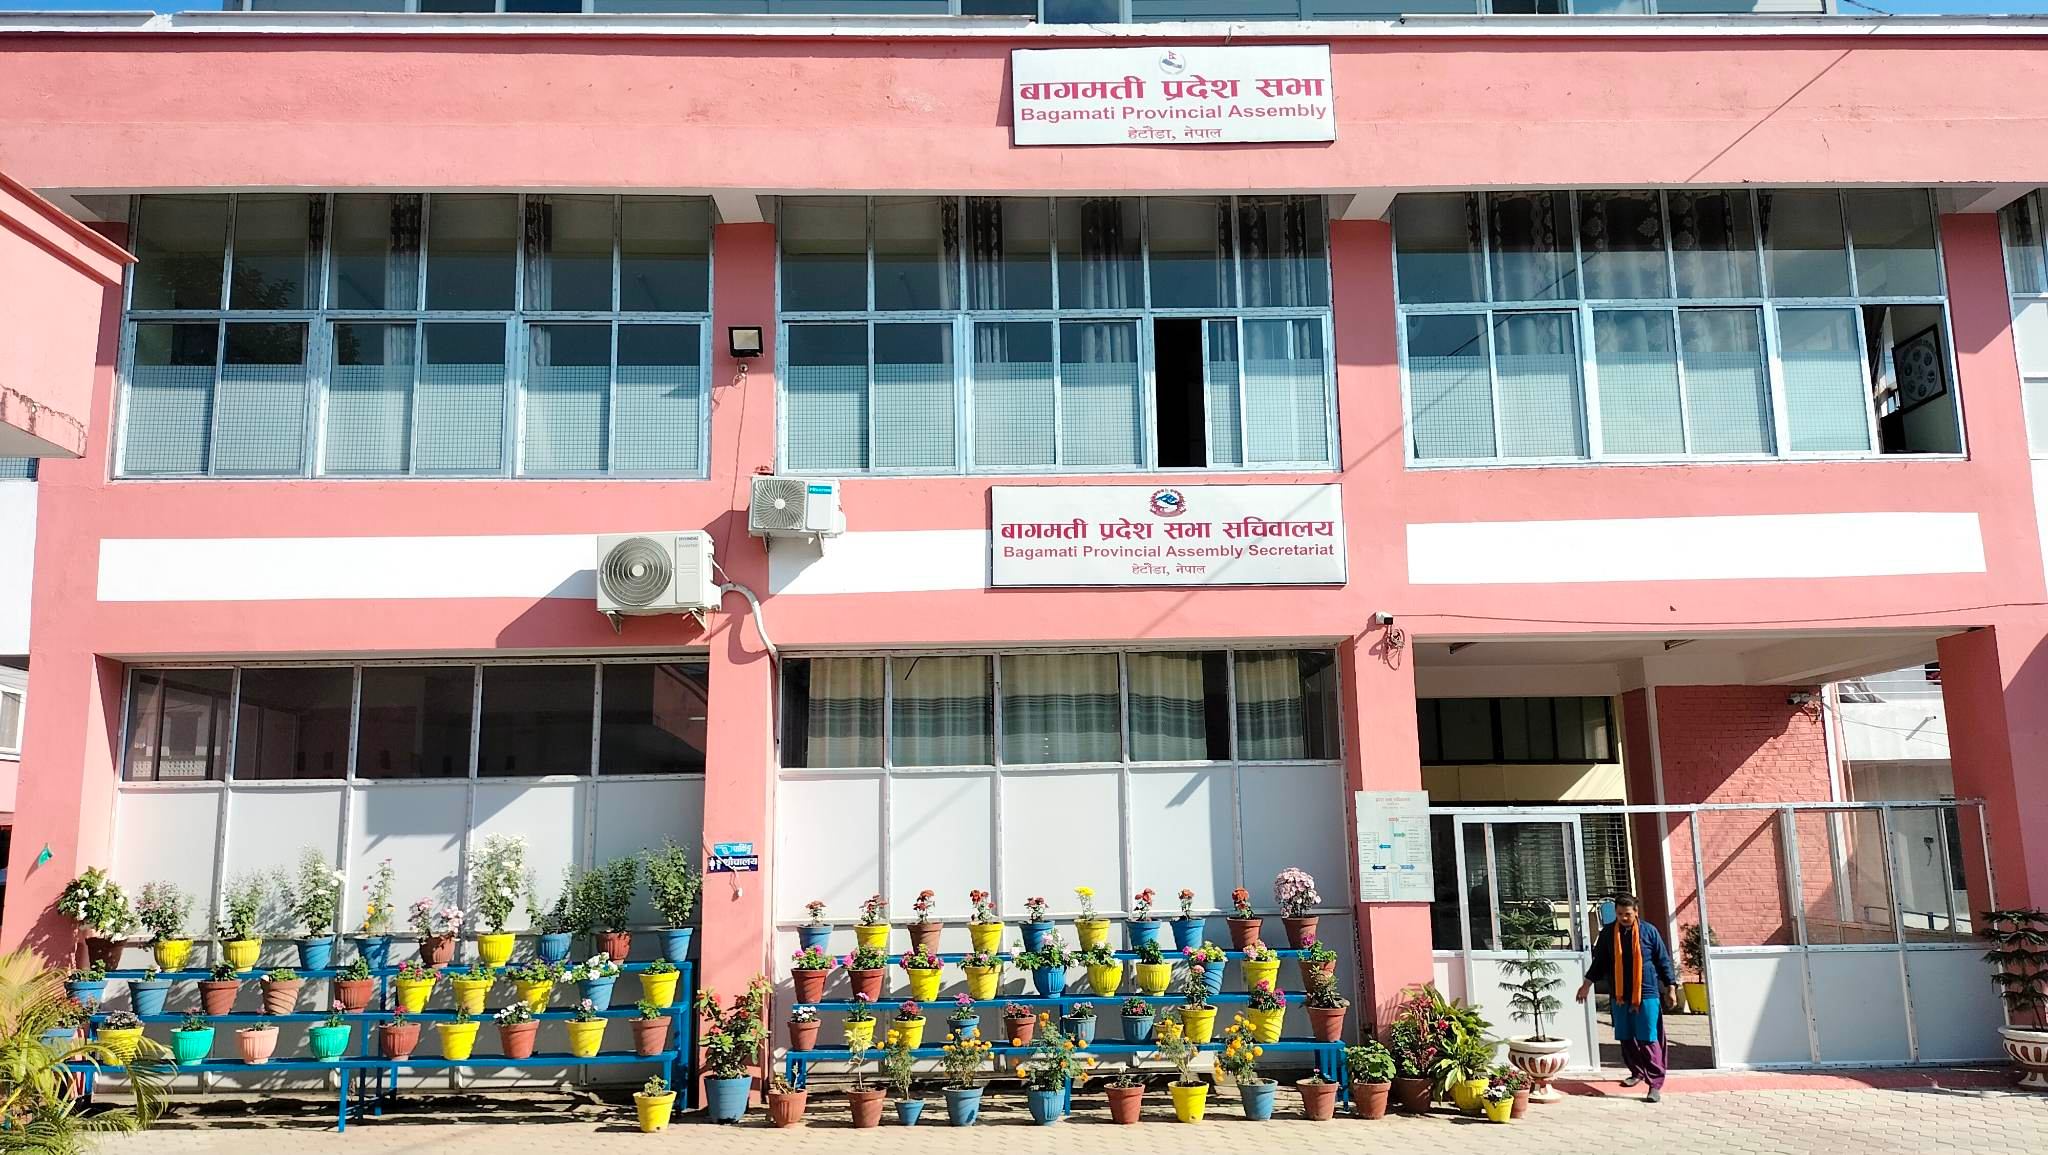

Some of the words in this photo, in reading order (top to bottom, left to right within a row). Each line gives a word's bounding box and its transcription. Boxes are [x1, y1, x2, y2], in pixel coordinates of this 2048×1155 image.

[1020, 76, 1146, 100] बागमती
[1161, 75, 1240, 101] प्रदेश
[1256, 78, 1324, 97] सभा
[1021, 107, 1114, 123] Bagamati
[1123, 105, 1221, 119] Provincial
[1228, 104, 1326, 119] Assembly
[1184, 126, 1222, 138] नेपाल
[1001, 518, 1088, 539] बागमती
[1099, 518, 1154, 541] प्रदेश
[1164, 523, 1212, 539] सभा
[1222, 516, 1334, 538] सचिवालय
[1003, 546, 1077, 560] Bagamati
[1083, 546, 1160, 557] Provincial
[1166, 545, 1245, 559] Assembly
[1249, 544, 1334, 556] Secretariat
[1176, 563, 1206, 574] नेपाल
